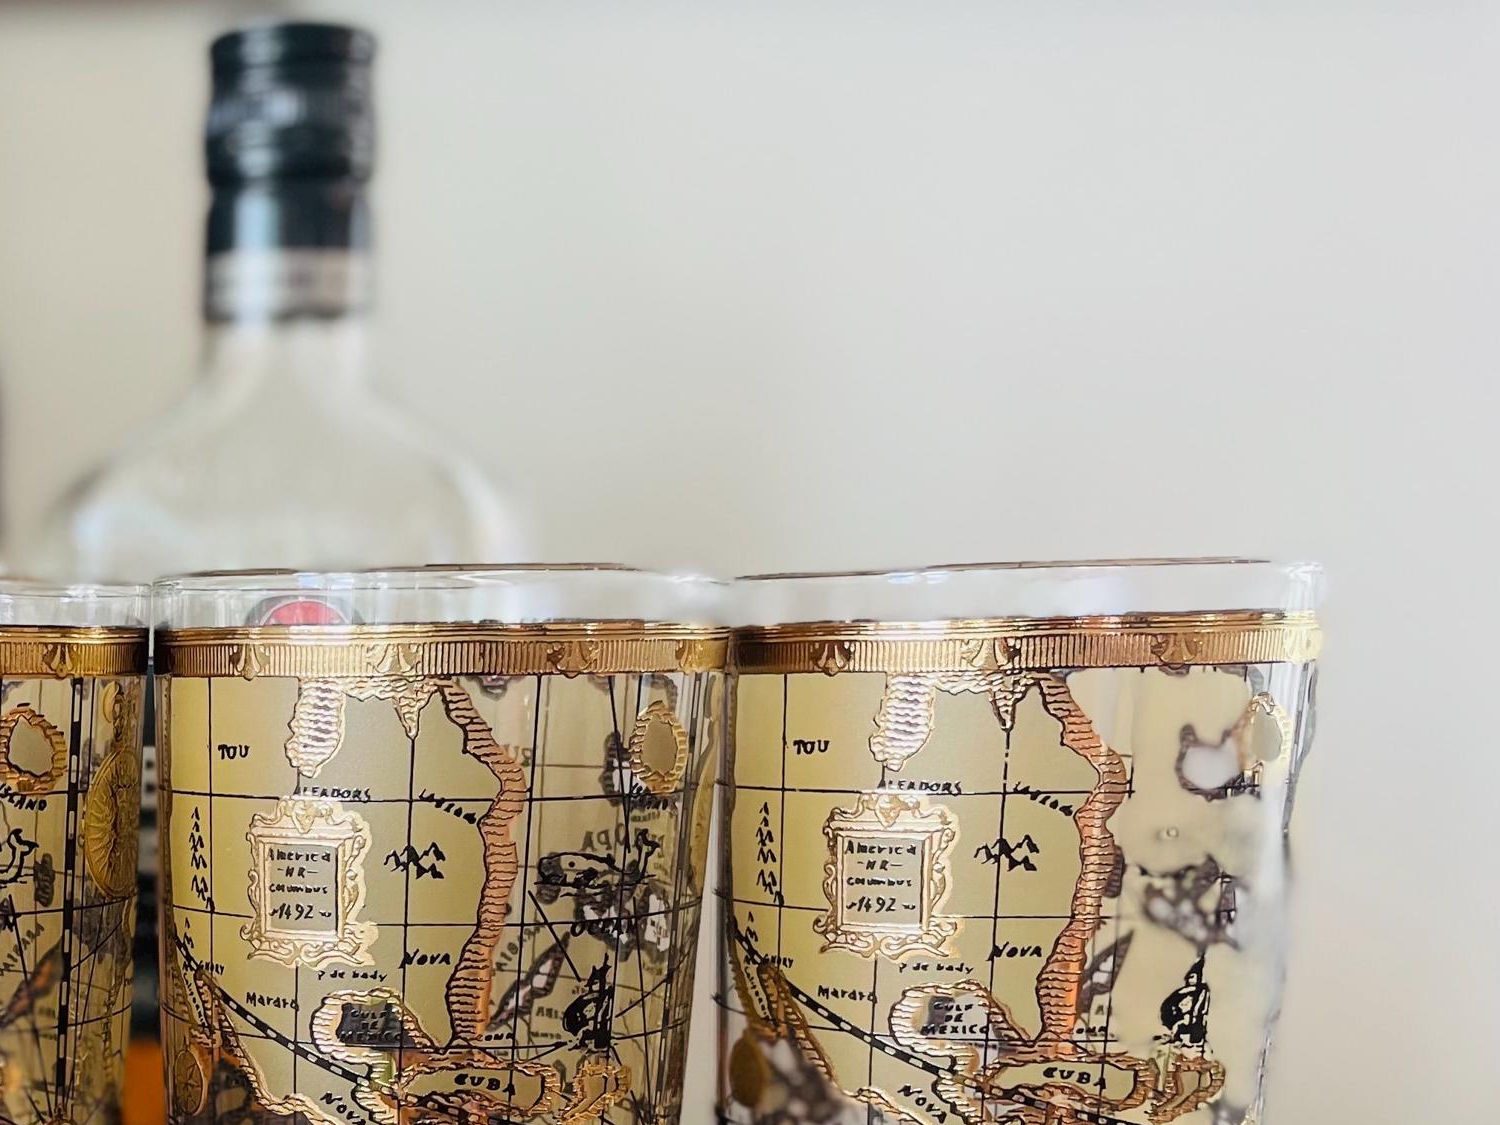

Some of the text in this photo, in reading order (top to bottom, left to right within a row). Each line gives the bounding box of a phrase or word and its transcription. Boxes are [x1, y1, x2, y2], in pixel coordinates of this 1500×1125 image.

[0, 783, 47, 811] ISLAND
[339, 1030, 402, 1042] MEXICO
[921, 1025, 988, 1035] MEXICO
[454, 1073, 515, 1096] CUBA
[1043, 1067, 1106, 1089] CUBA
